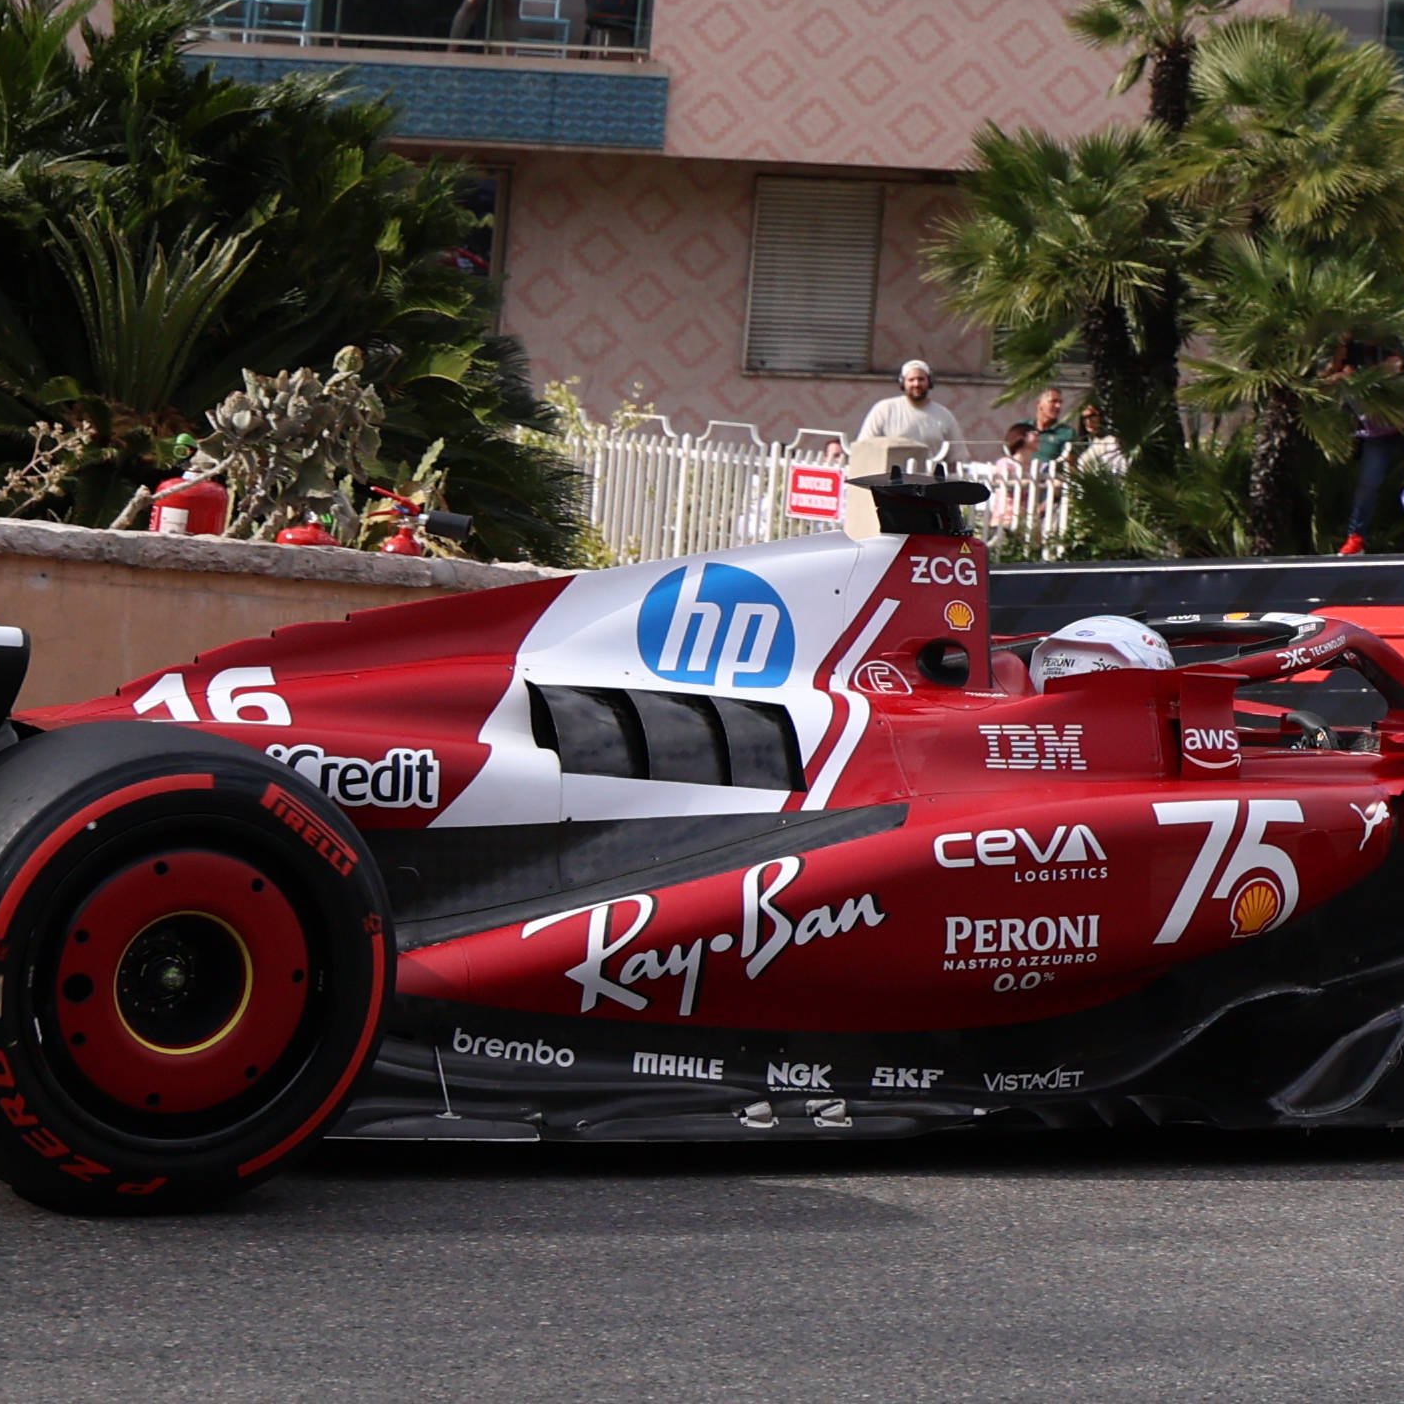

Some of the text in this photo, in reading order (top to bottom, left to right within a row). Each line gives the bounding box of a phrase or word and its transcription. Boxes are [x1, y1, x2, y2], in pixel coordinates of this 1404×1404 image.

[658, 561, 779, 688] hp
[132, 666, 292, 726] 16
[978, 724, 1087, 771] IBM
[1184, 728, 1239, 754] aws
[260, 781, 360, 877] PIRELLI
[1014, 866, 1108, 883] LOGISTICS
[1151, 799, 1305, 945] 75
[944, 914, 1100, 955] PERONI
[942, 953, 1098, 971] NASTRO AZZURRO
[452, 1028, 575, 1068] brembo
[633, 1051, 724, 1080] MAHLE
[766, 1061, 832, 1089] NGK
[871, 1065, 944, 1089] SKF
